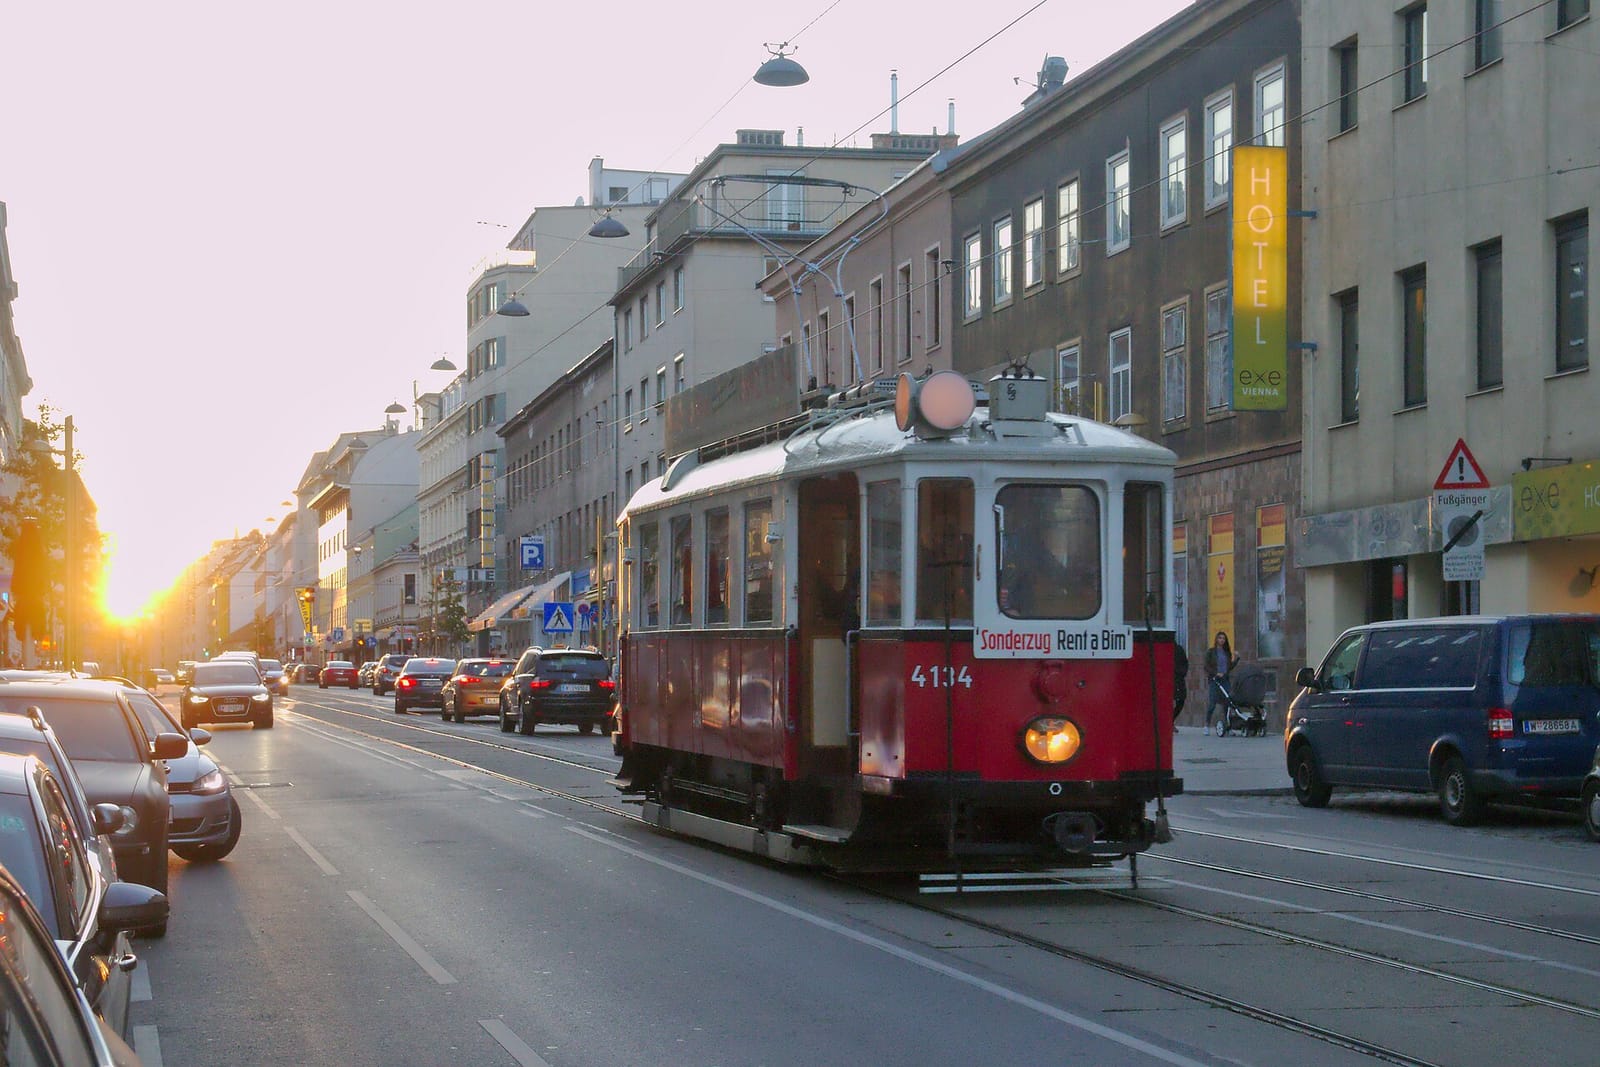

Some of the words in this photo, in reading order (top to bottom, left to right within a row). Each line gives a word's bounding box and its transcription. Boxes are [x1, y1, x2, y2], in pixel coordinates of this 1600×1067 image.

[1248, 168, 1273, 344] HOTEL
[1239, 370, 1280, 386] exe
[1242, 387, 1278, 396] VIENNA
[1438, 494, 1487, 506] Fußgänger
[1521, 483, 1560, 512] exe
[523, 545, 539, 564] P
[981, 630, 1051, 654] Sonderzug
[1057, 631, 1088, 651] Rent
[1091, 634, 1098, 651] a
[1102, 630, 1126, 651] Bim
[911, 665, 973, 688] 4134
